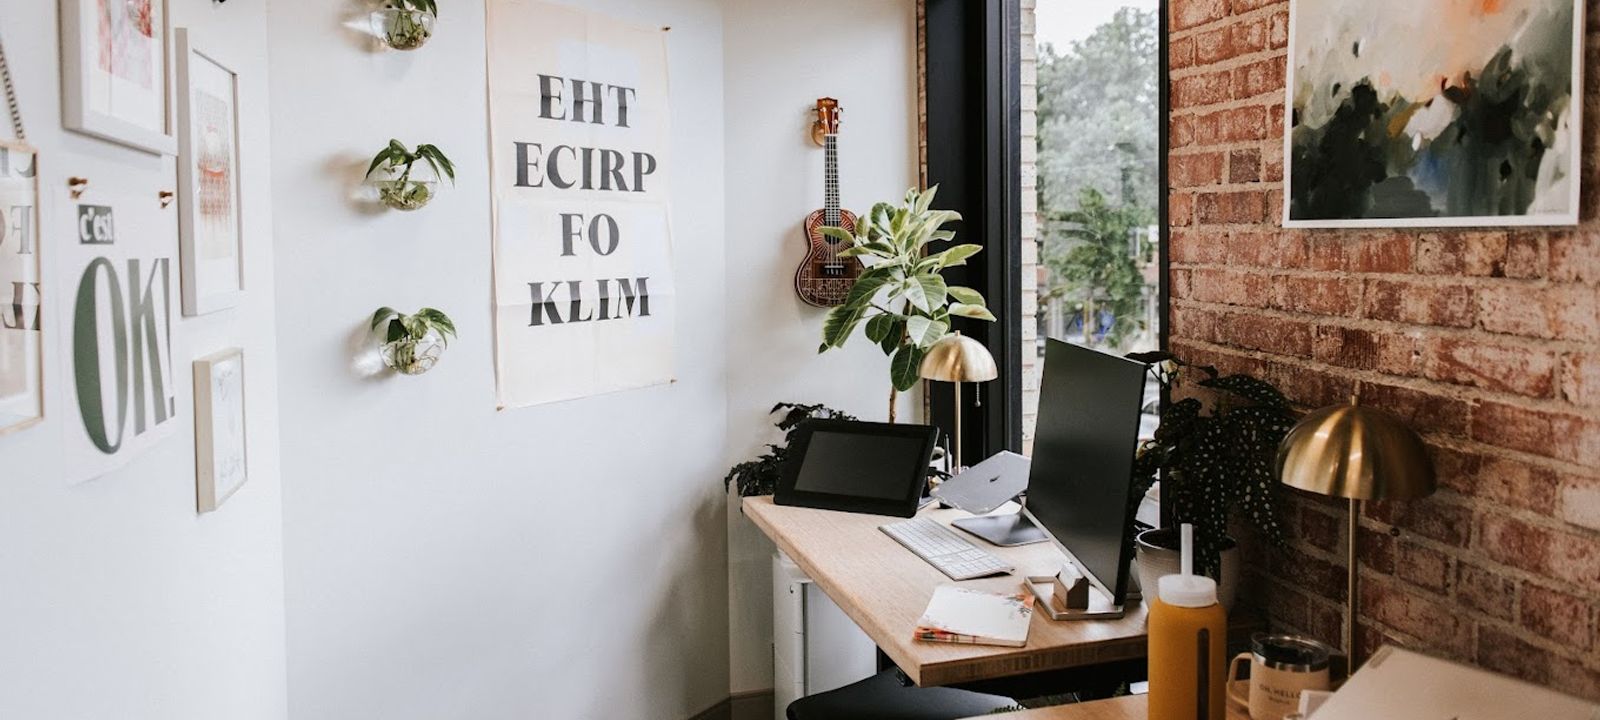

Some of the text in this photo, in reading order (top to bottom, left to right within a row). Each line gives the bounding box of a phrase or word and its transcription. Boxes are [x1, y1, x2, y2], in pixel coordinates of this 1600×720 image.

[536, 73, 636, 129] EHT
[512, 141, 657, 193] ECIRP
[559, 213, 620, 257] FO
[527, 276, 652, 327] KLIM
[73, 256, 176, 455] OK!
